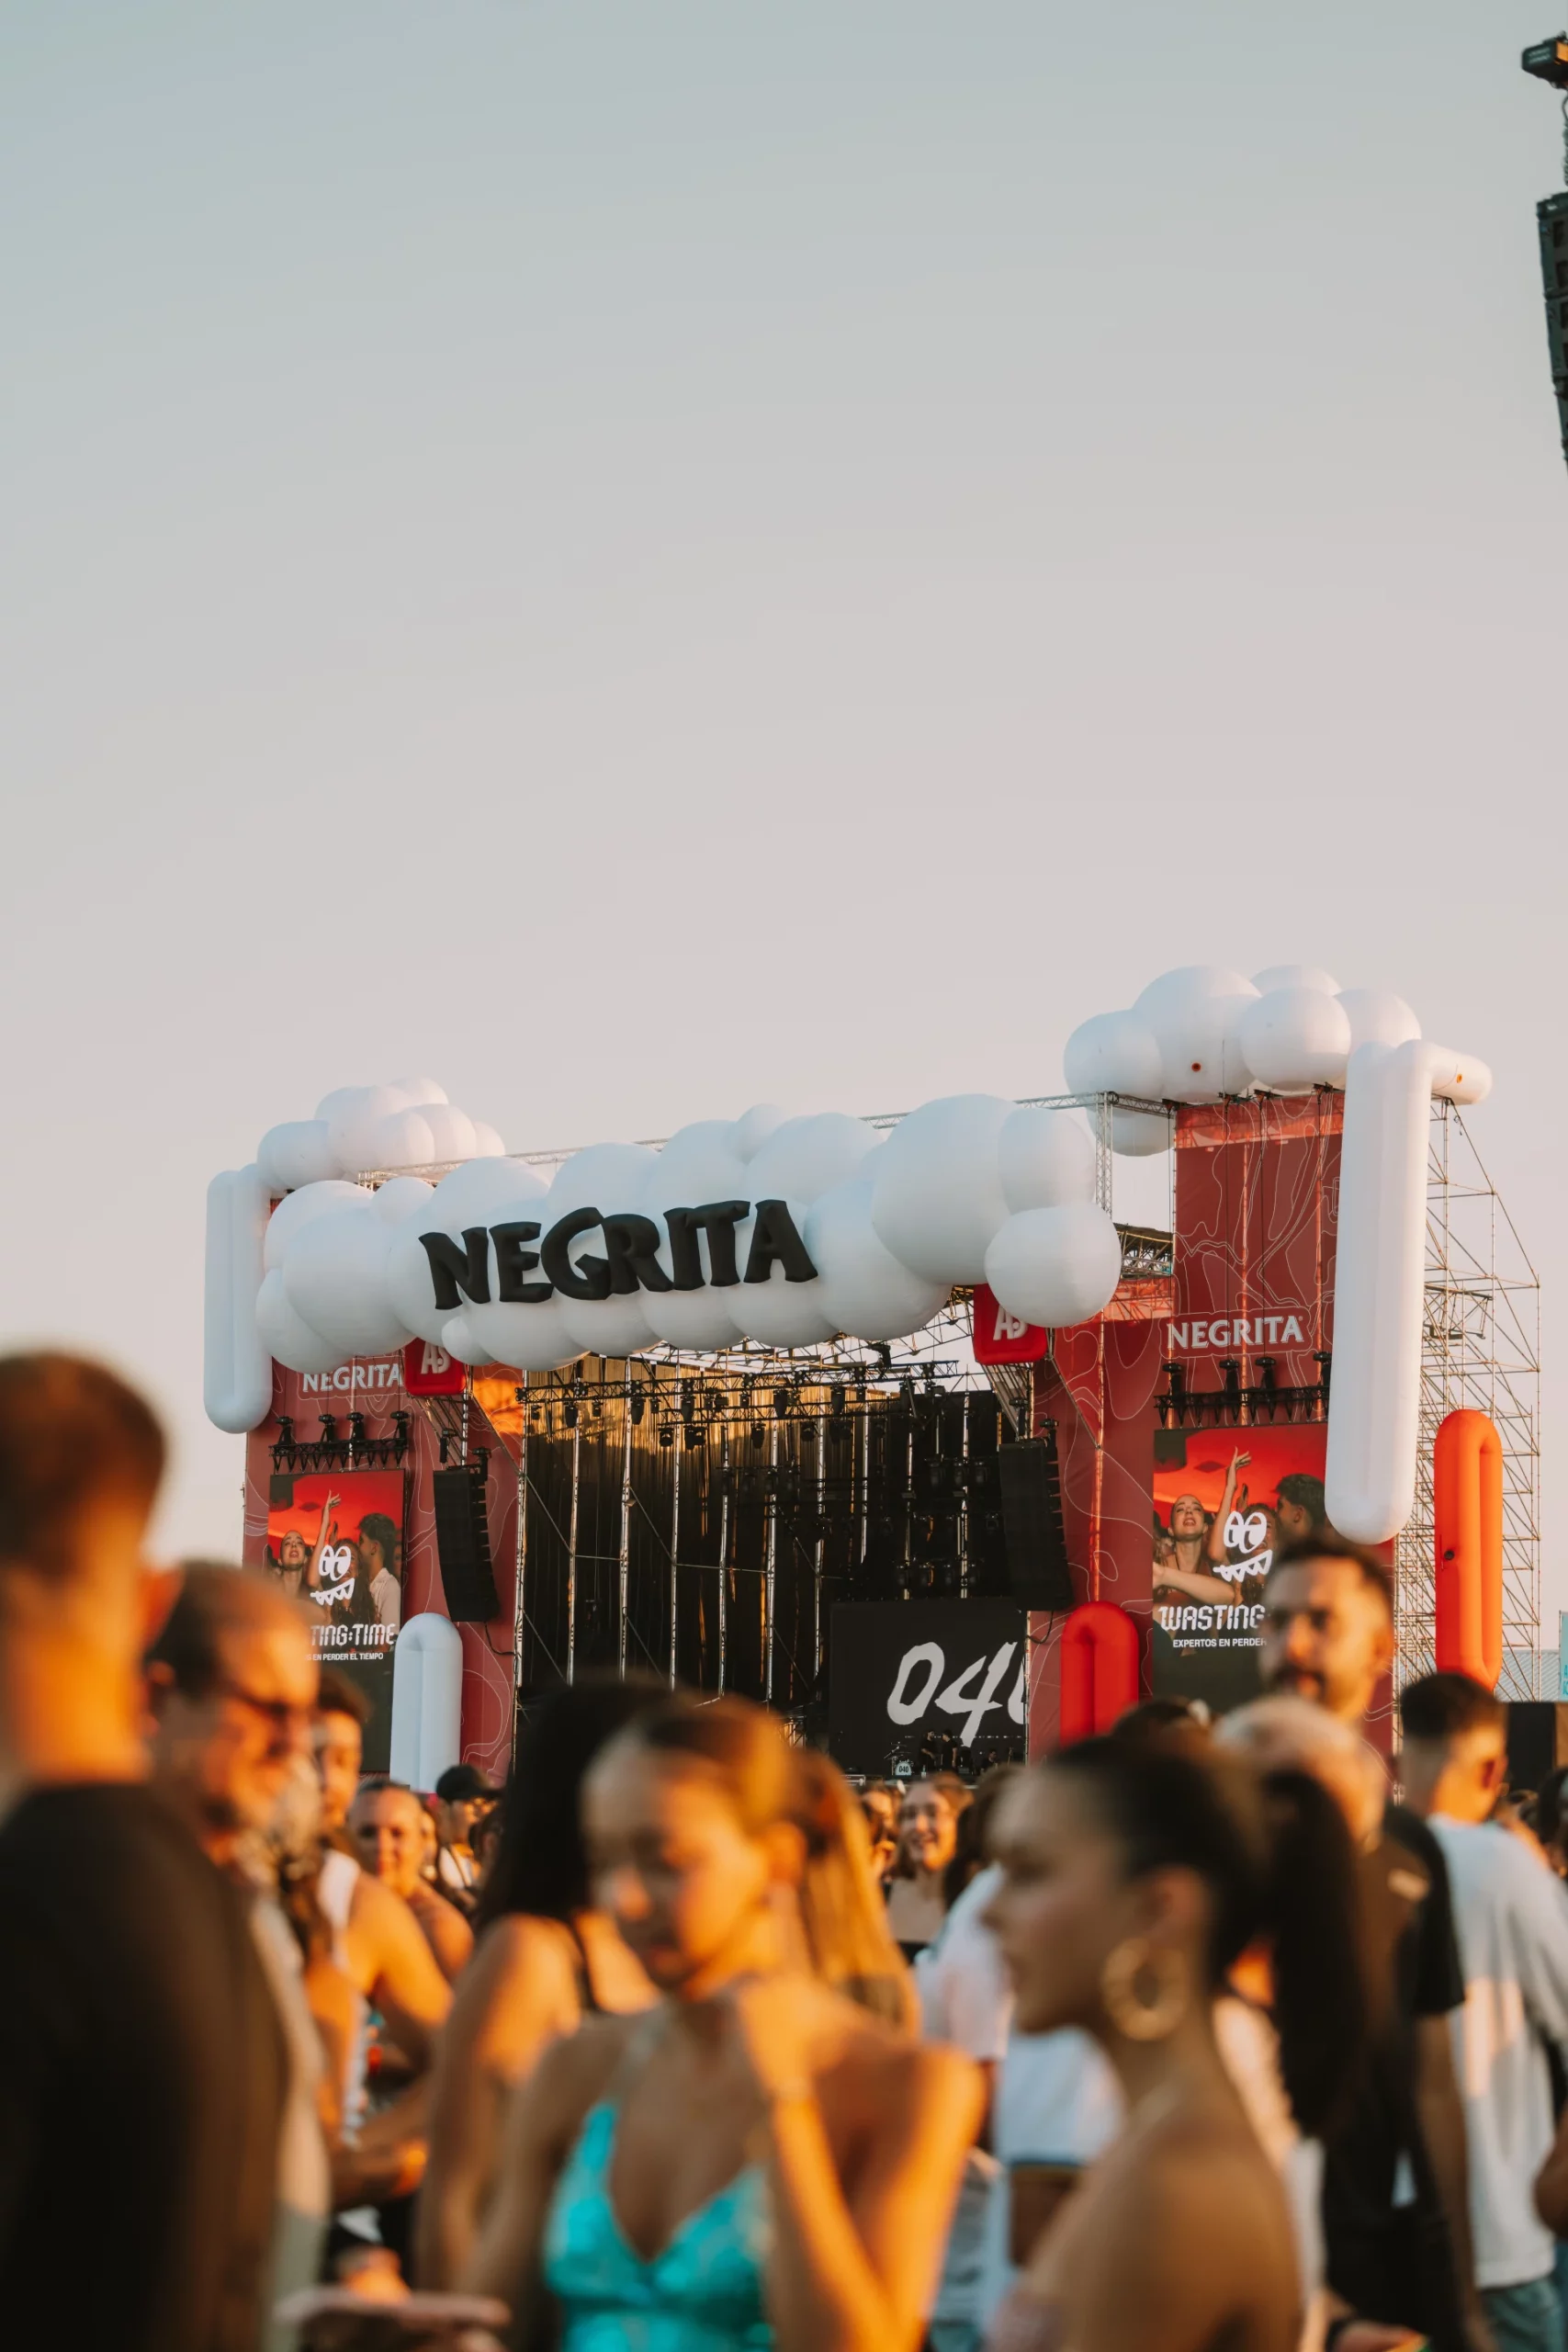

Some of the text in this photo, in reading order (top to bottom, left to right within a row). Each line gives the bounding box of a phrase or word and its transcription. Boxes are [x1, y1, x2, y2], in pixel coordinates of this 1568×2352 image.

[418, 1199, 818, 1310] NEGRITA
[1167, 1316, 1304, 1350] NEGRITA
[302, 1363, 403, 1393] NEGRITA
[1157, 1603, 1266, 1631] WASTING
[310, 1623, 396, 1646] TING:TIME
[1173, 1638, 1217, 1647] EXPERTOS
[1219, 1638, 1231, 1647] EN
[312, 1653, 321, 1661] EN
[322, 1653, 349, 1661] PERDER
[360, 1652, 384, 1660] TIEMPO
